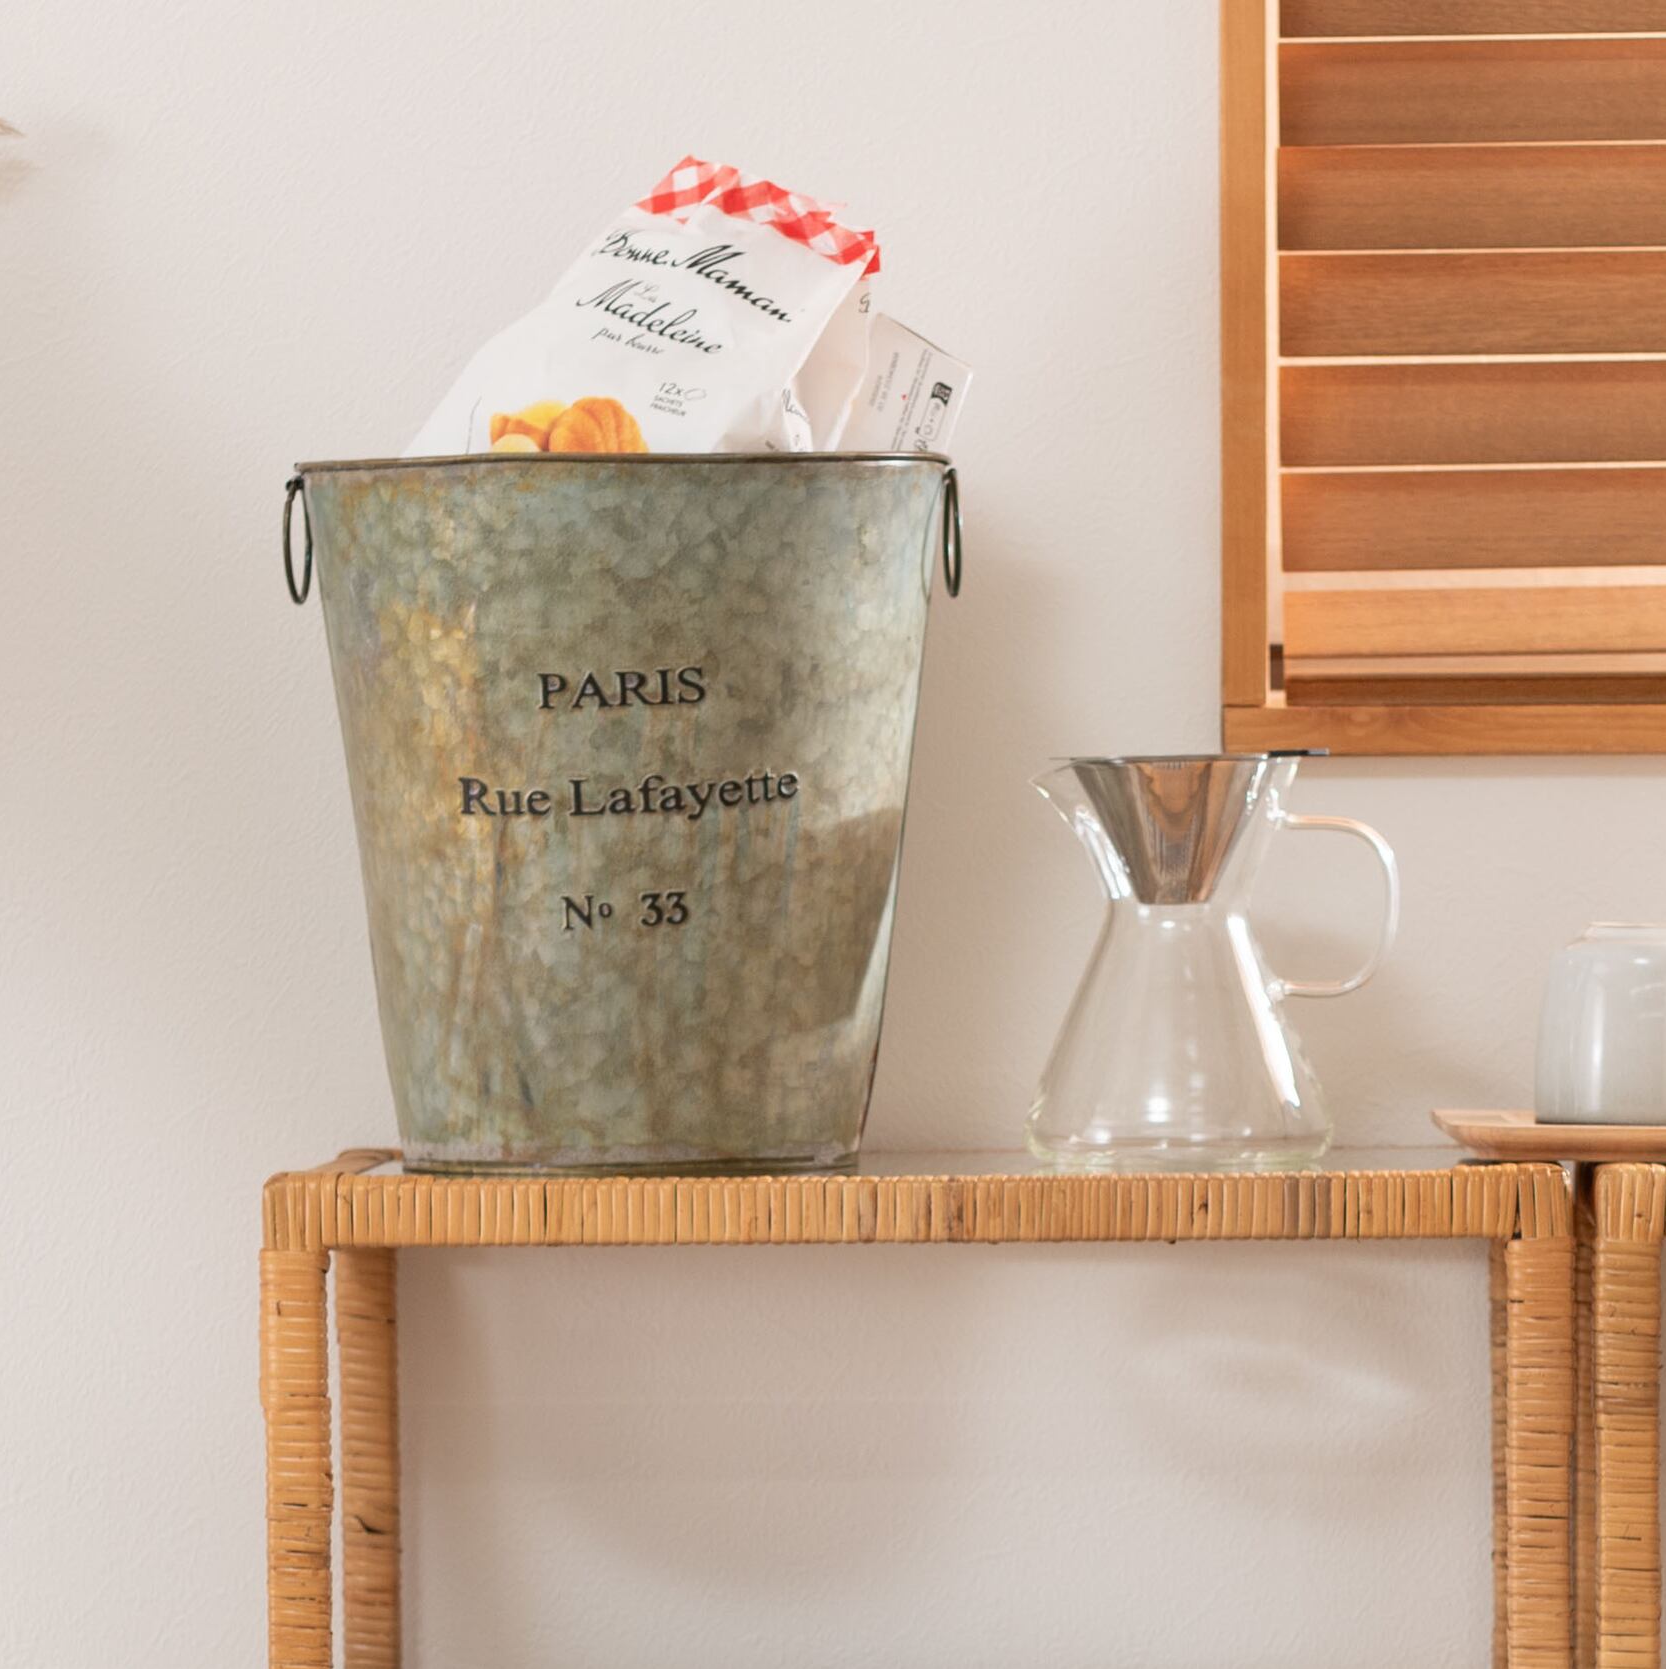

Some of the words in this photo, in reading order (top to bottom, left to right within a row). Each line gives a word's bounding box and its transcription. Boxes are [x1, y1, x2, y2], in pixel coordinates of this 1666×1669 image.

[671, 245, 792, 322] Maman
[576, 279, 722, 354] Madeleine
[538, 667, 707, 709] PARIS
[459, 777, 551, 816] Rue
[569, 771, 799, 820] Lafayette
[641, 892, 689, 927] 33
